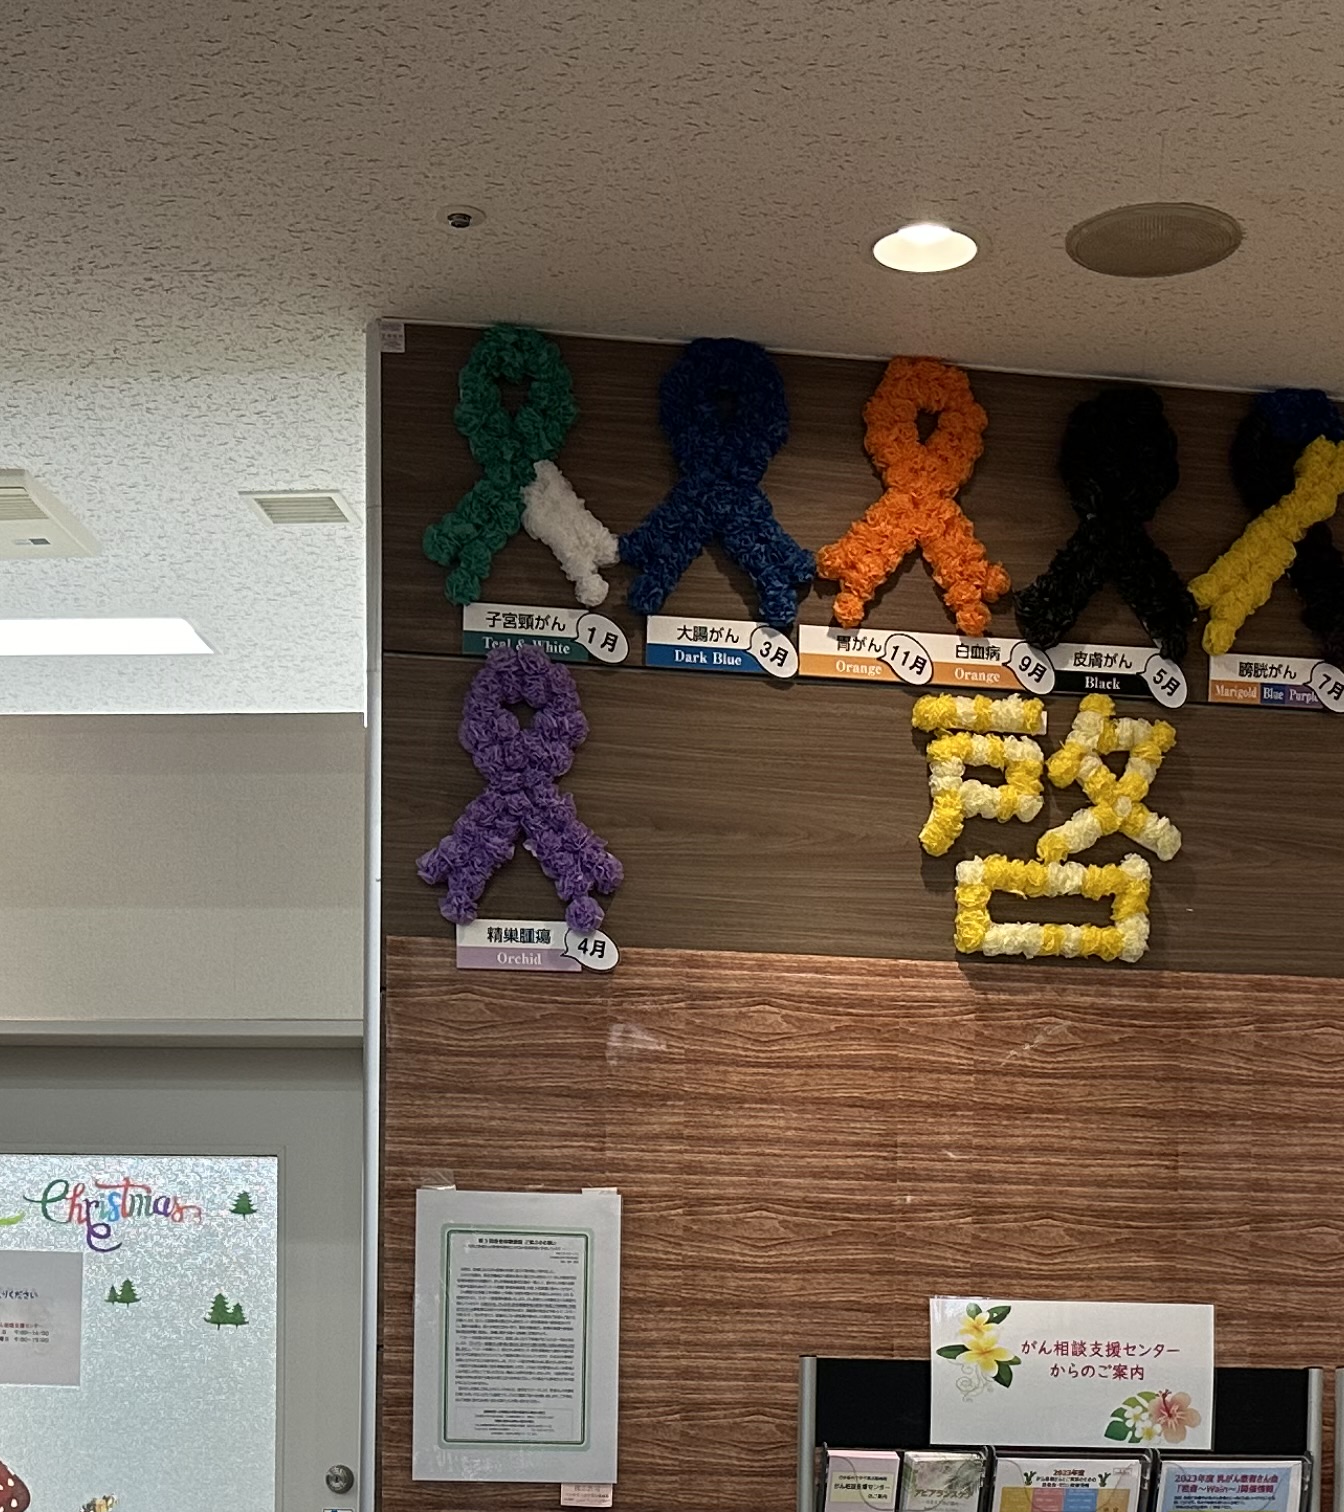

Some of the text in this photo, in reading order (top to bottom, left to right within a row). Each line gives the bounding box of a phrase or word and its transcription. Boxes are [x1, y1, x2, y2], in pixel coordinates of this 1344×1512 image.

[485, 610, 566, 631] 子宮頸がん
[585, 627, 620, 653] 1月
[676, 624, 740, 644] 大腸がん
[759, 640, 790, 667] 3月
[836, 635, 882, 653] 胃がん
[955, 644, 1001, 662] 白血病
[674, 649, 743, 667] Dark Blue
[888, 643, 926, 676] 11月
[1072, 650, 1133, 669] 皮膚がん
[835, 660, 883, 677] Orange
[954, 667, 1001, 683] Orange
[1017, 655, 1047, 683] 9月
[1238, 661, 1297, 680] 膀胱がん
[1084, 674, 1121, 691] Black
[1152, 667, 1181, 697] 5月
[1214, 684, 1257, 700] Marigold
[1262, 687, 1285, 701] Blue
[487, 926, 552, 944] 精巣腫瘍
[577, 937, 606, 959] 4月
[496, 951, 543, 966] Orchid
[22, 1177, 203, 1253] Christmas
[1020, 1339, 1181, 1359] がん相談支援センター
[1049, 1362, 1146, 1382] からのご案内
